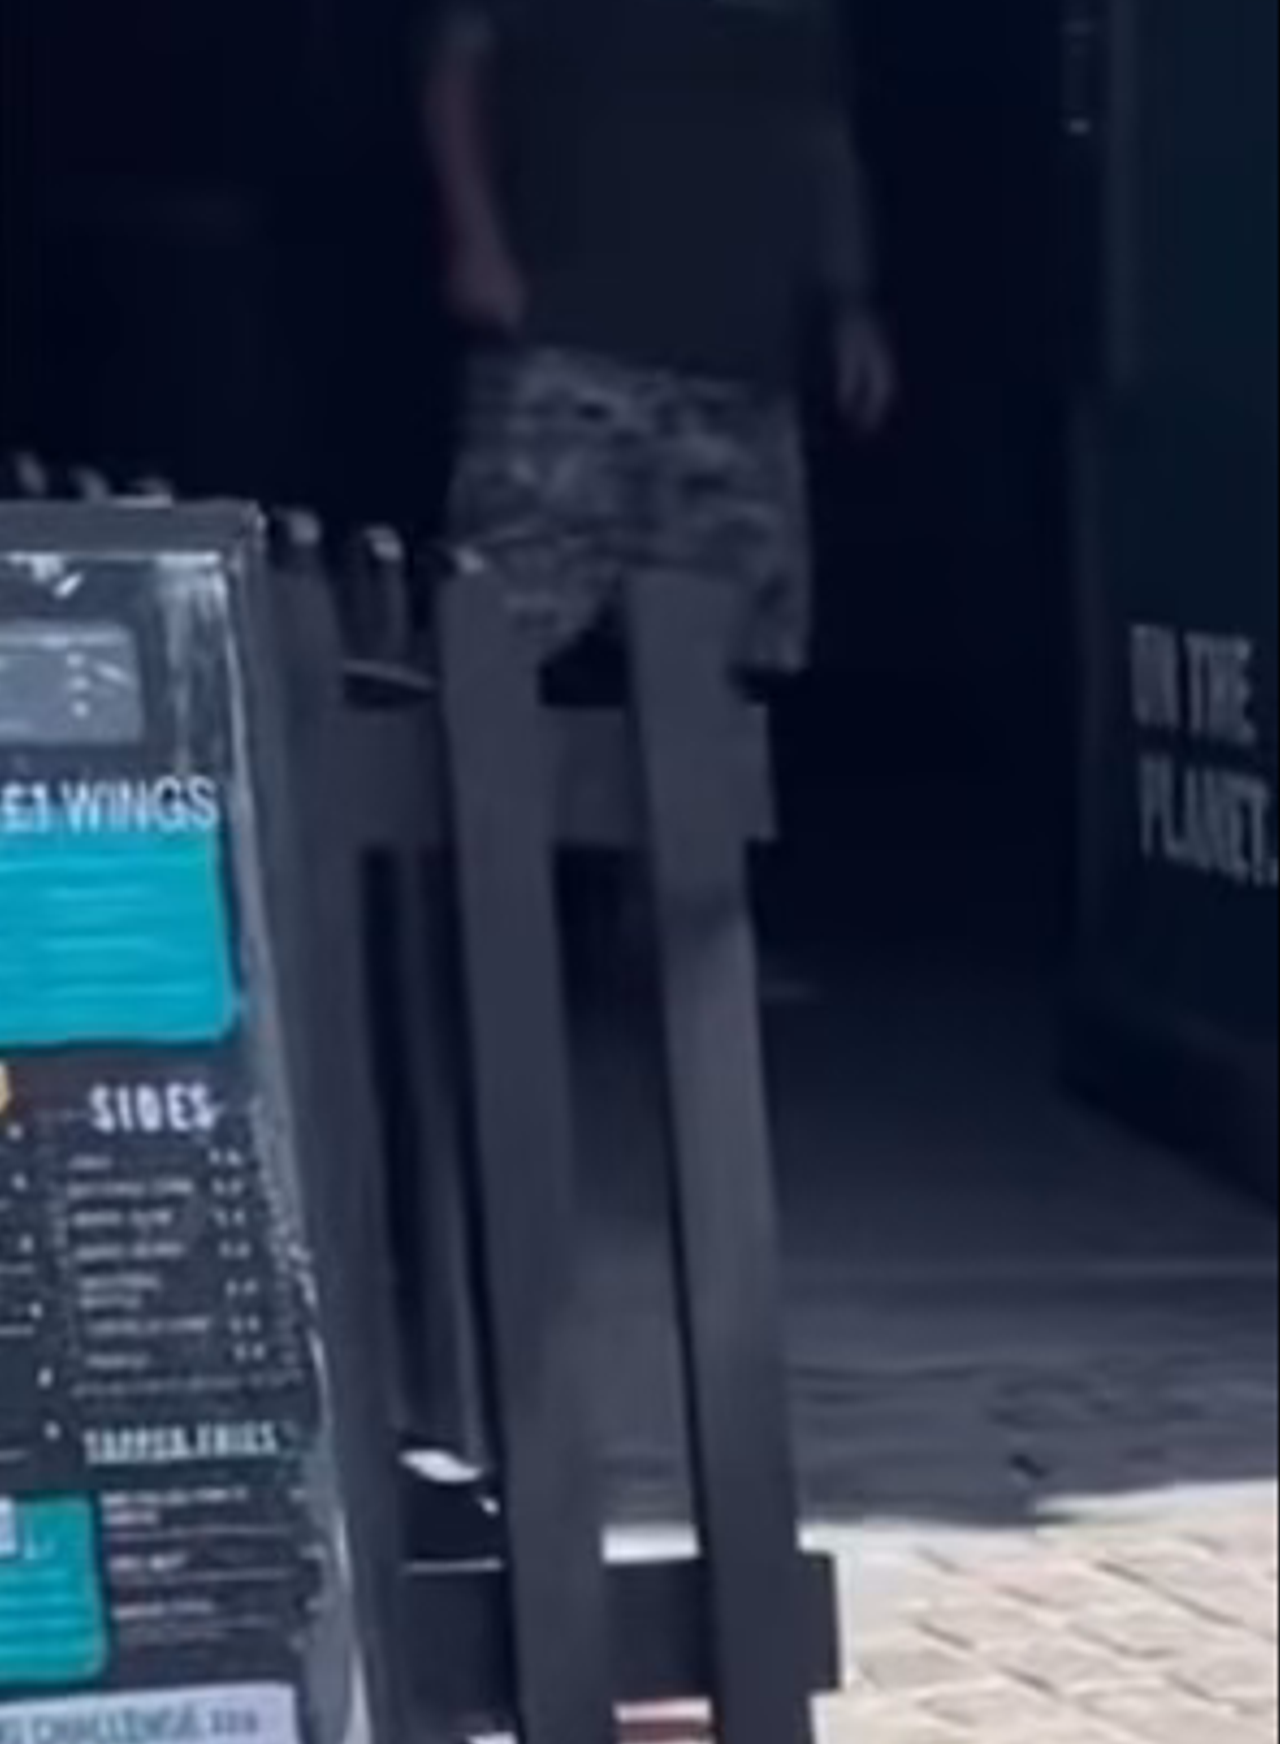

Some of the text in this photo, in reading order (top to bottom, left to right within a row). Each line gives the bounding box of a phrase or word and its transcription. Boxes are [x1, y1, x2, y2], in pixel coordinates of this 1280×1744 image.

[1184, 630, 1258, 746] THE
[59, 772, 222, 835] WINGS
[88, 1082, 216, 1132] SIDES
